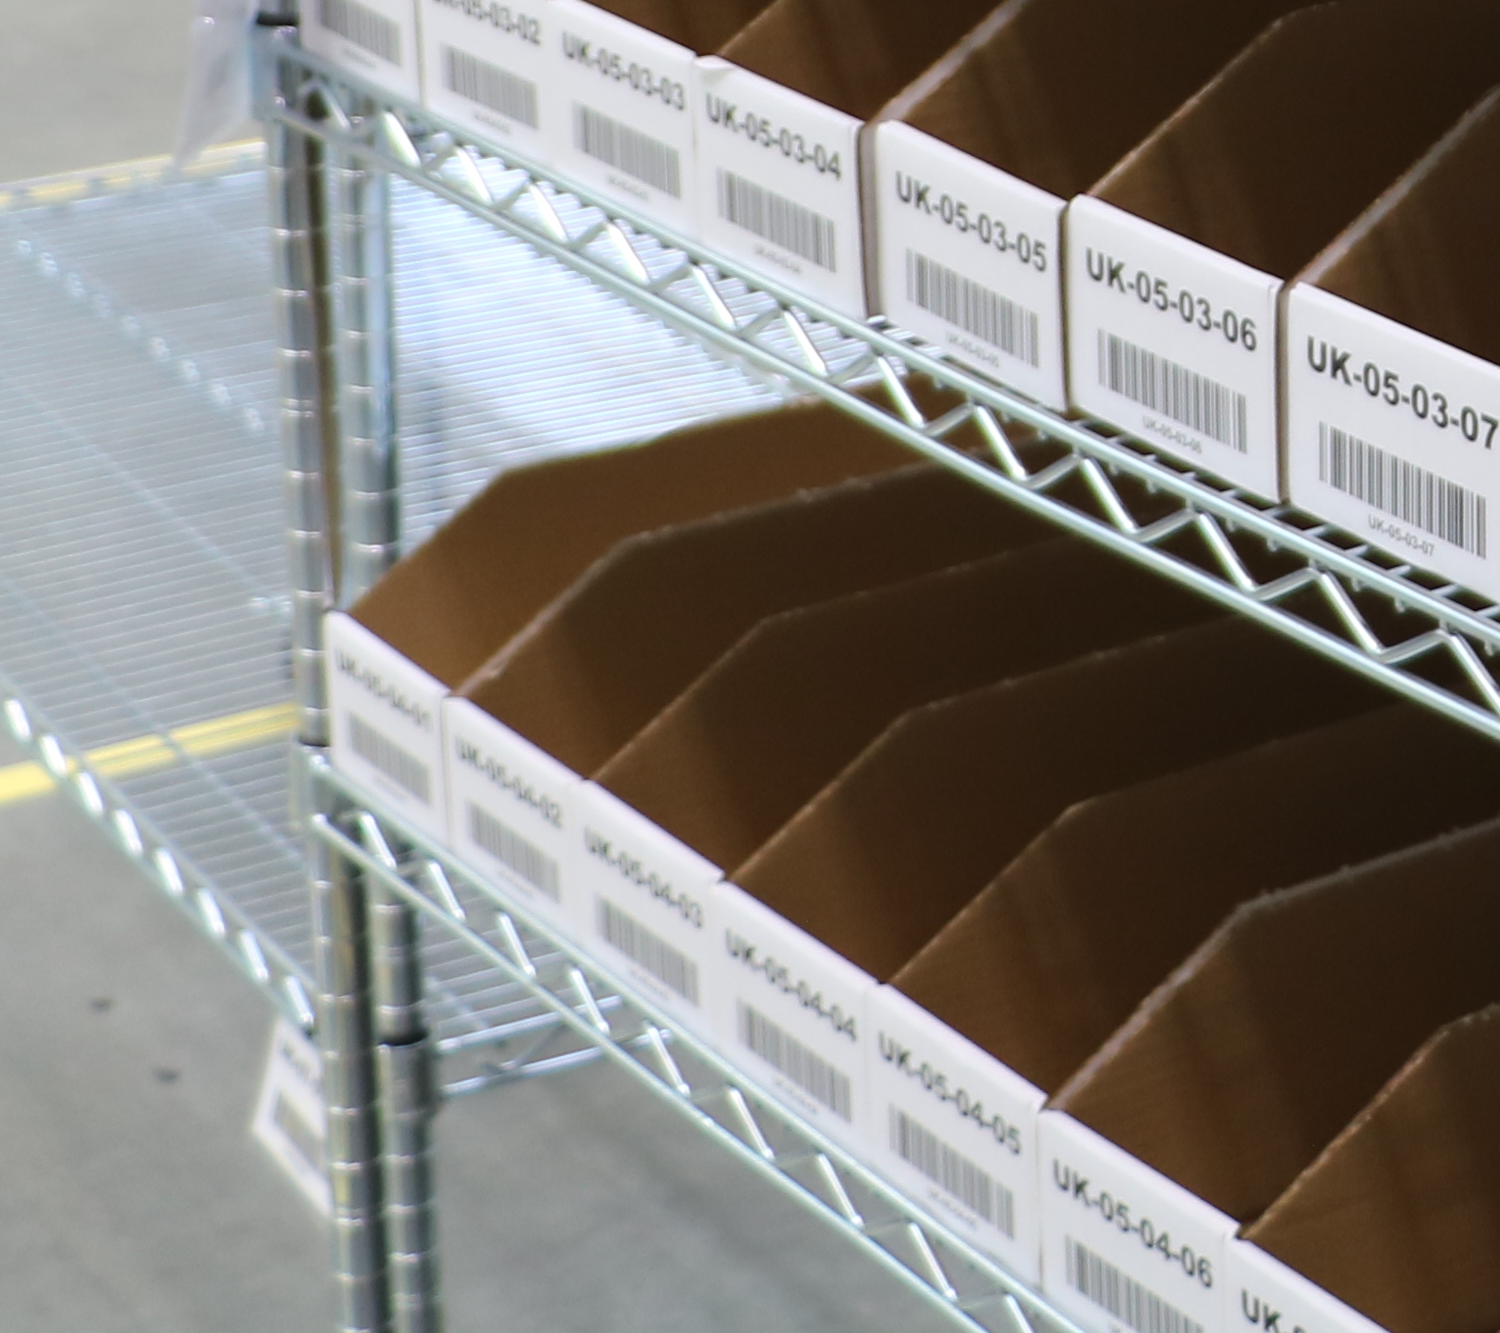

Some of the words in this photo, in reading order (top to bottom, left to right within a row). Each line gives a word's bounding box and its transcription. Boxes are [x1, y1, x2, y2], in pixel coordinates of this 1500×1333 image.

[562, 32, 686, 112] UK-05-03-03
[706, 93, 842, 181] UK-05-03-04
[895, 171, 1047, 273] UK-05-03-05
[1086, 248, 1257, 352] UK-05-03-06
[1307, 337, 1499, 449] UK-05-03-07
[878, 1032, 1022, 1156] UK-05-04-05
[1053, 1160, 1213, 1289] UK-05-04-06
